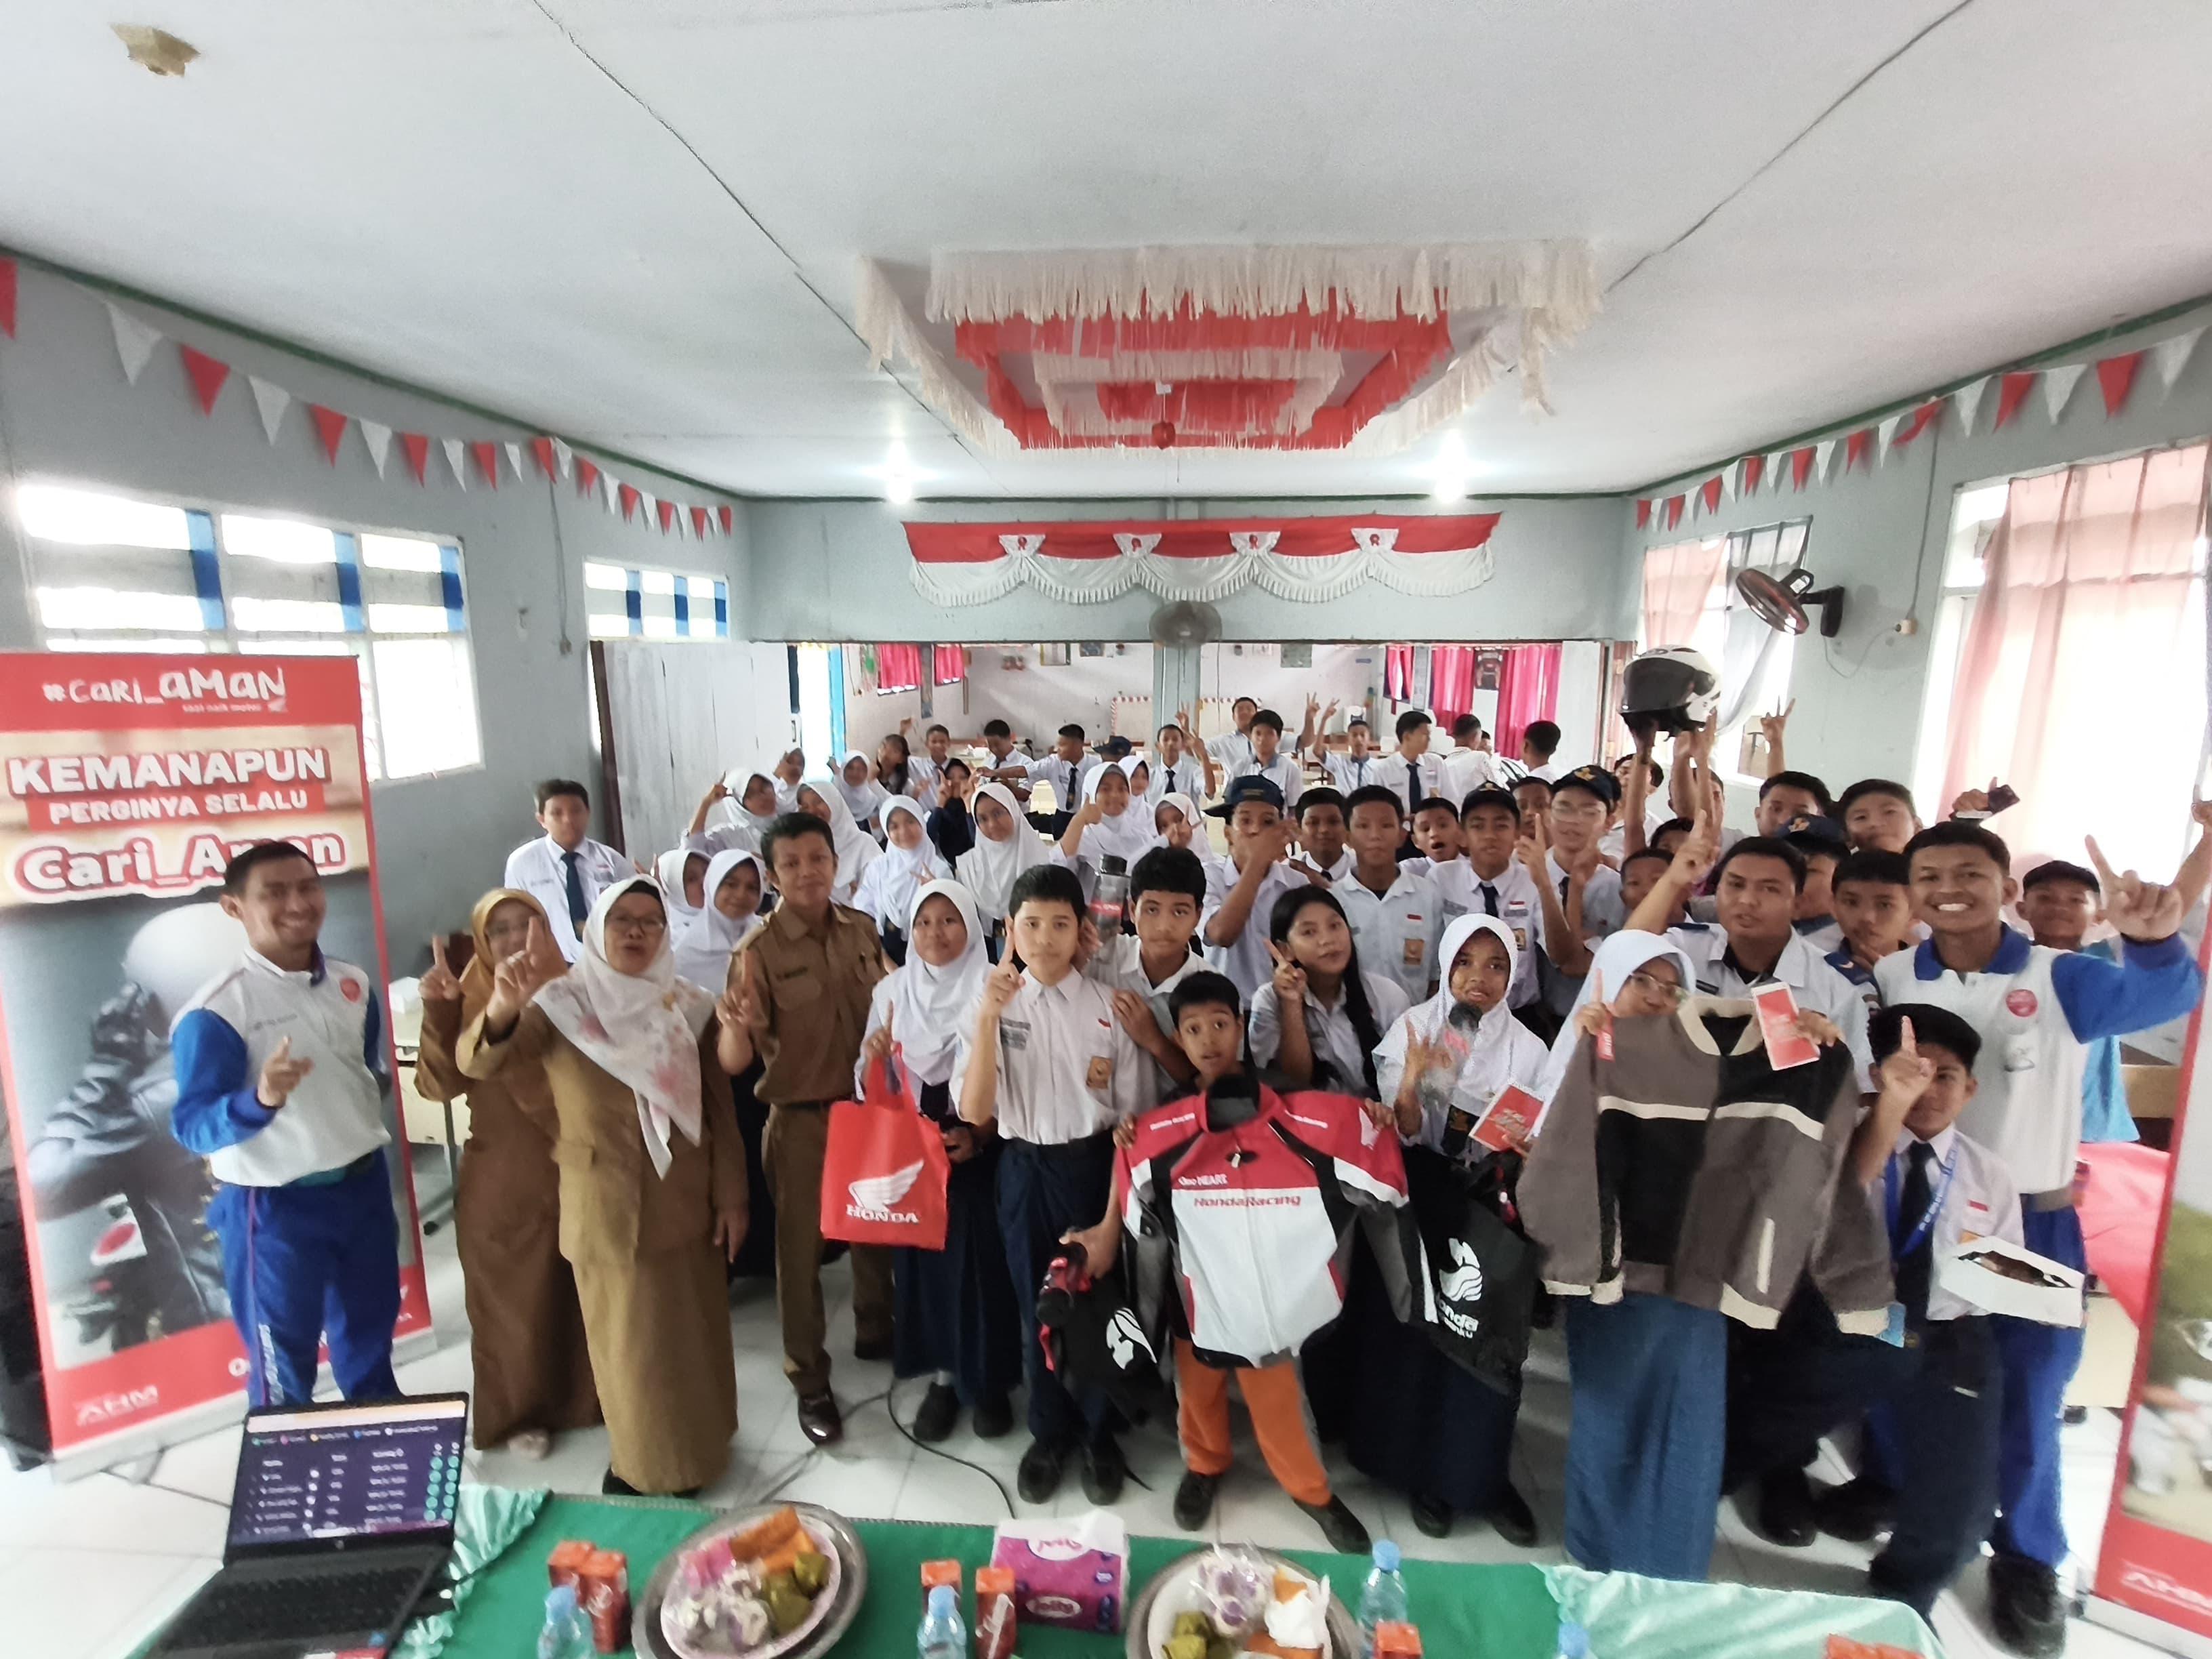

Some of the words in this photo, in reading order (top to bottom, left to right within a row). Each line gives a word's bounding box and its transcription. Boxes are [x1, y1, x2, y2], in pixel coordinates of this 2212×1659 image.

[8, 748, 328, 795] KEMANAPUN
[50, 796, 199, 824] PERGINYA
[205, 790, 308, 815] SELALU
[23, 834, 341, 890] Cari_An
[846, 1204, 920, 1223] HONDA
